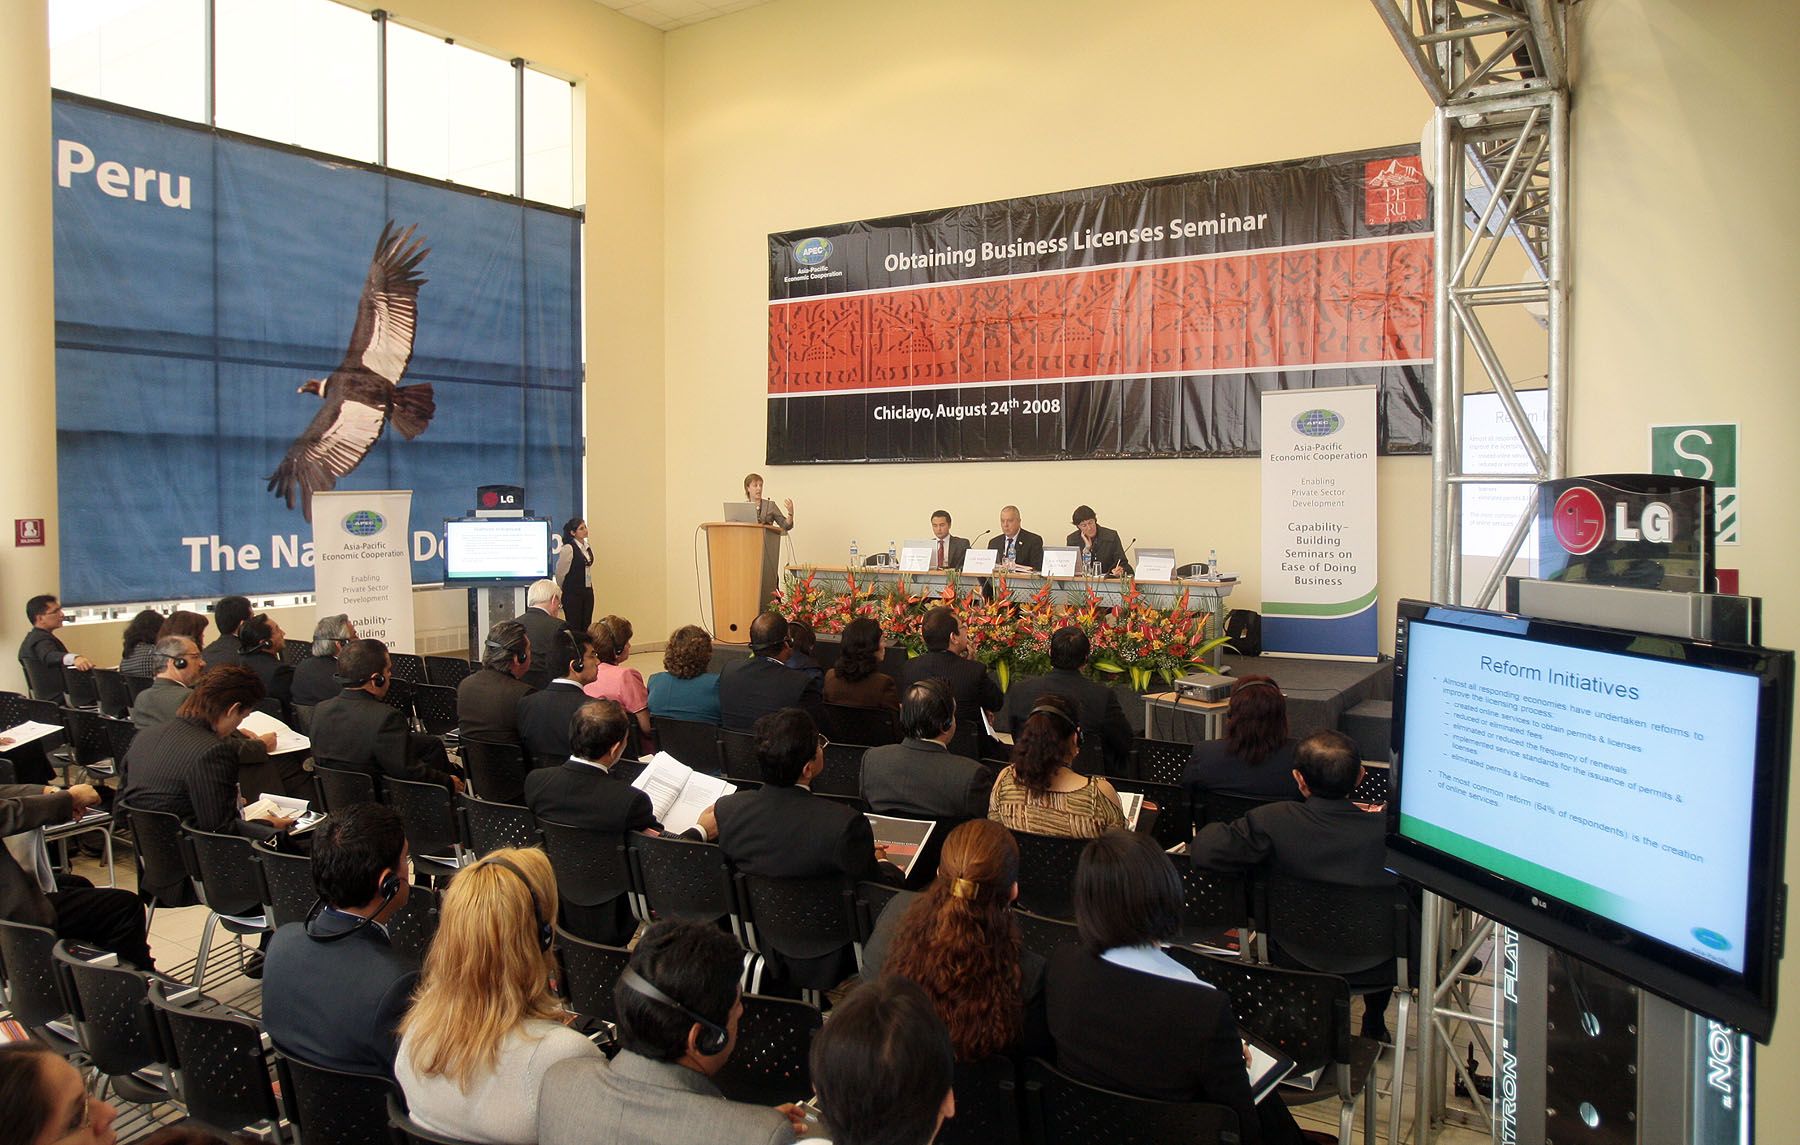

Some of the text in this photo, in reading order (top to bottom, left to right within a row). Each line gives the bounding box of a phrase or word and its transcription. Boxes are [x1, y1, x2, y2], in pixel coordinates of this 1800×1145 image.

[58, 139, 191, 210] Peru
[884, 212, 1268, 272] Obtaining Business Licenses Seminar
[803, 246, 823, 256] APEC
[784, 270, 842, 282] Economic Cooperation
[798, 266, 828, 274] Asia-Pacific
[874, 398, 1061, 422] Chiclayo, August 24th 2008
[1294, 442, 1342, 452] Asia-Pacific
[1270, 451, 1368, 462] Economic Cooperation
[1674, 430, 1714, 481] S
[1301, 477, 1335, 486] Enabling
[1320, 488, 1346, 496] Sector
[500, 495, 514, 504] LG
[1292, 500, 1344, 508] Development
[1288, 522, 1349, 533] Capability-
[1616, 502, 1674, 544] LG
[344, 542, 386, 550] Asia-Pacific
[1296, 536, 1341, 547] Building
[182, 534, 261, 572] The
[322, 550, 404, 561] Economic Cooperation
[1286, 549, 1334, 558] Seminars
[1281, 562, 1357, 574] Ease of Doing
[351, 574, 380, 583] Enabling
[1295, 576, 1343, 586] Business
[342, 584, 389, 594] Private Sector
[344, 594, 389, 605] Development
[1480, 656, 1640, 700] Reform Initiatives
[1443, 688, 1470, 700] improve
[1486, 696, 1518, 711] licensing
[1443, 677, 1467, 688] Almost
[1479, 686, 1520, 701] responding
[1522, 695, 1567, 711] economies
[1570, 704, 1591, 716] have
[1594, 711, 1647, 728] undertaken
[1651, 722, 1690, 738] reforms
[1694, 731, 1704, 741] to
[1454, 712, 1480, 724] reduced
[1454, 702, 1478, 712] created
[1479, 708, 1499, 717] online
[1502, 713, 1530, 725] services
[1532, 720, 1540, 728] to
[1541, 721, 1564, 733] obtain
[1567, 728, 1597, 742] permits
[1599, 735, 1605, 744] &
[1496, 735, 1524, 746] reduced
[1526, 742, 1538, 751] the
[1540, 745, 1578, 762] frequency
[1485, 764, 1511, 776] permits
[1496, 746, 1520, 757] service
[1522, 754, 1559, 768] standards
[1560, 762, 1572, 772] for
[1573, 767, 1586, 776] the
[1588, 772, 1625, 787] issuance
[1639, 785, 1673, 801] permits
[1675, 794, 1682, 803] &
[1446, 784, 1467, 796] online
[1439, 771, 1452, 780] The
[1453, 776, 1470, 787] most
[1472, 783, 1504, 798] common
[1507, 793, 1531, 806] reform
[1632, 834, 1640, 842] is
[1643, 837, 1658, 848] the
[1661, 844, 1704, 863] creation
